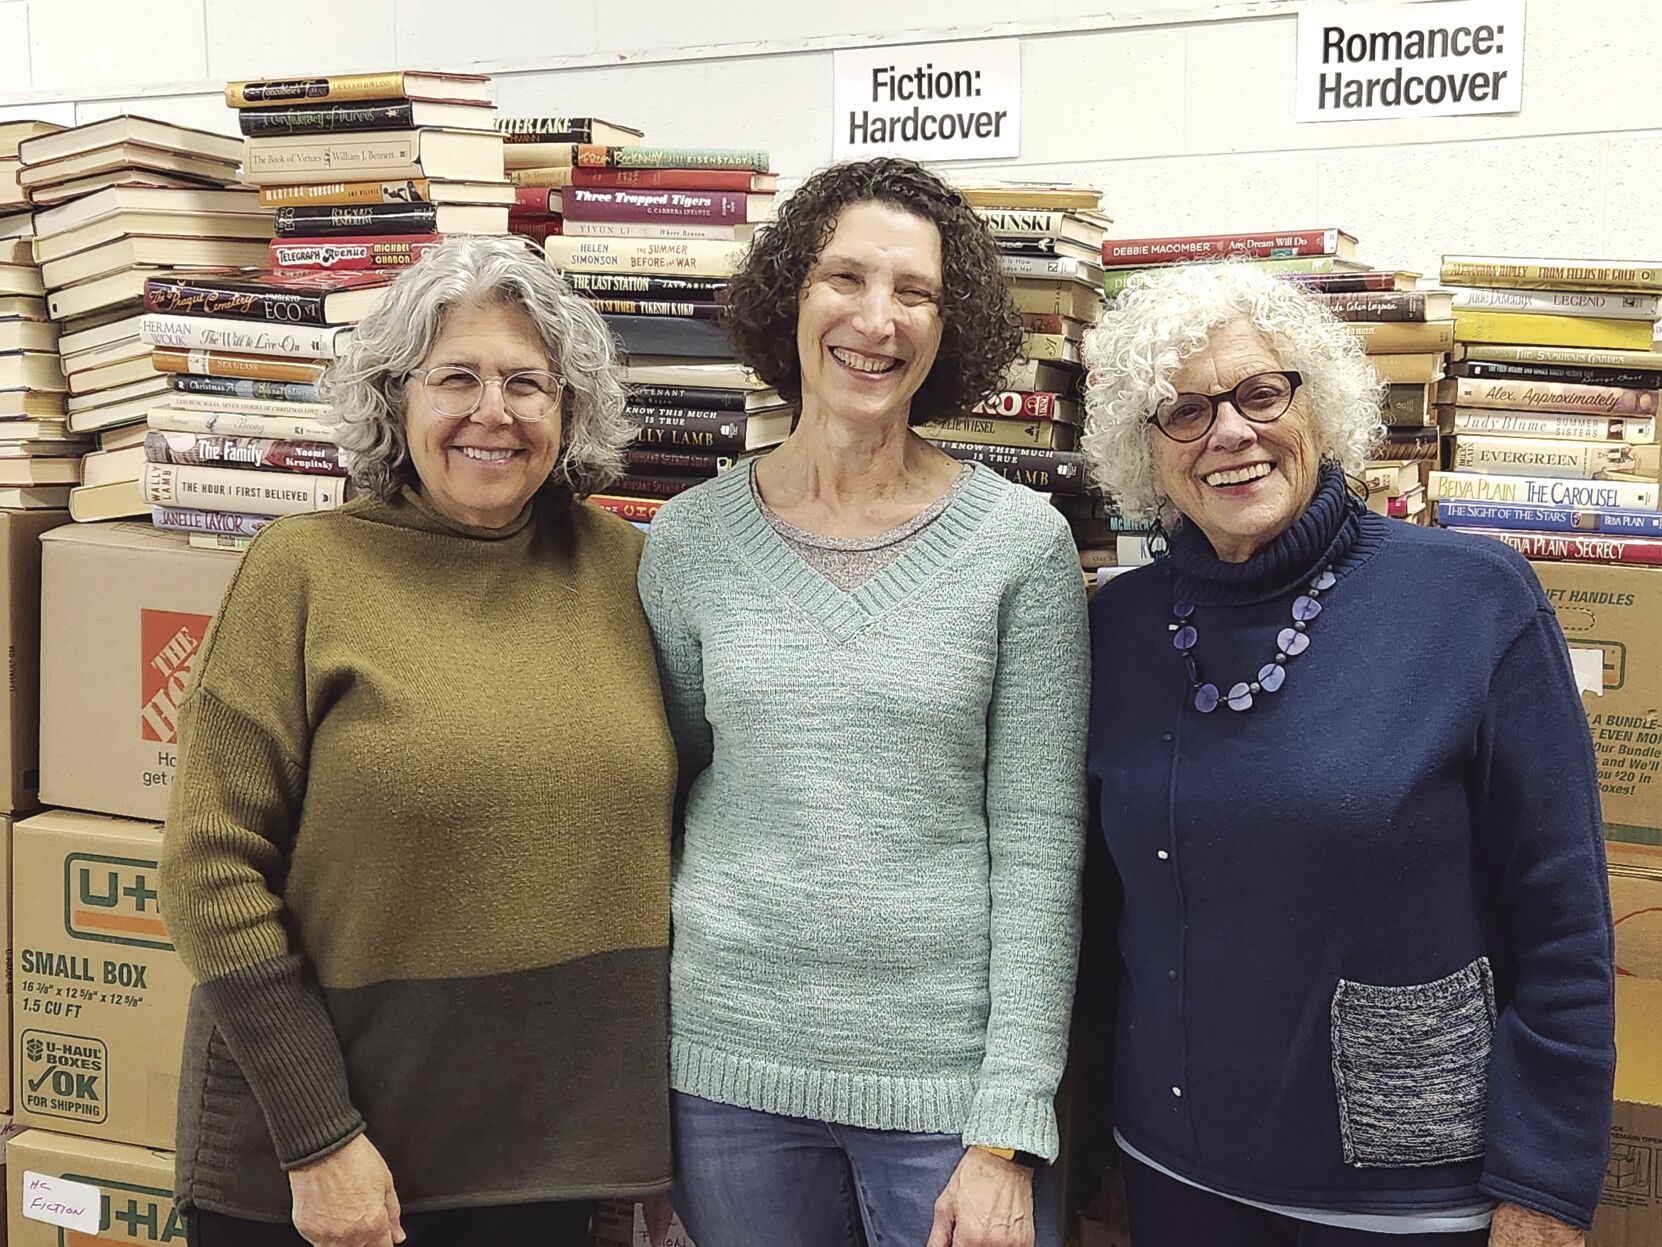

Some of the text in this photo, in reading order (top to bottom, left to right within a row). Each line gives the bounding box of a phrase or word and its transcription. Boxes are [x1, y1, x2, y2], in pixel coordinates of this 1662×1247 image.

[1322, 25, 1505, 64] Romance:
[872, 63, 981, 102] Fiction:
[1318, 67, 1508, 110] Hardcover
[535, 117, 572, 134] LAKE
[849, 106, 1007, 145] Hardcover
[253, 154, 267, 164] The
[267, 154, 286, 164] Book
[286, 153, 295, 162] of
[332, 151, 360, 161] William
[368, 150, 394, 160] Bennett
[613, 151, 663, 168] ROCKAWAY
[687, 154, 748, 165] EISENSTADT
[575, 190, 712, 207] Three Trapped Tigers
[580, 225, 631, 235] YIYUN LI
[980, 212, 1052, 232] OSINSKI
[659, 229, 681, 237] Where
[279, 247, 367, 263] TELEGRAPH Avenue
[373, 243, 410, 253] MICHAEL
[580, 243, 609, 253] HELEN
[648, 244, 688, 256] SUMMER
[1112, 237, 1307, 257] DEBBIE MACOMBER Dream Will Do
[571, 254, 618, 266] SIMONSON
[630, 256, 696, 269] BEFORE WAR
[1499, 265, 1529, 278] RIPLEY
[1538, 266, 1564, 279] FROM
[1566, 268, 1597, 280] FIELDS
[1598, 268, 1608, 281] OF
[1612, 269, 1636, 281] GOLD
[573, 274, 650, 292] THE LAST STATION
[203, 292, 260, 314] Cemetery
[1346, 301, 1368, 312] Cohen
[1553, 295, 1606, 308] LEGEND
[264, 301, 302, 322] ECO
[143, 319, 192, 335] HERMAN
[153, 334, 187, 347] WOUK
[200, 330, 220, 346] The
[1516, 350, 1533, 360] THE
[1587, 352, 1625, 364] GARDEN
[233, 361, 259, 371] GLASS
[190, 380, 225, 393] Christmas
[1485, 386, 1620, 412] Alex, Approximately
[625, 406, 718, 420] KNOW THIS MUCH
[645, 416, 686, 426] IS TRUE
[963, 419, 995, 434] WIESEL
[1463, 413, 1599, 432] Judy Blume SUMMER
[671, 430, 714, 447] LAMB
[1554, 428, 1598, 438] SISTERS
[199, 440, 263, 467] The Family
[294, 447, 326, 459] Naomi
[951, 442, 985, 452] KNOW
[988, 445, 1016, 455] THIS
[1020, 449, 1054, 458] MUCH
[1480, 449, 1578, 467] EVERGREEN
[285, 457, 333, 471] Krupitsky
[988, 454, 1018, 464] TRUE
[151, 466, 162, 501] WALLY
[162, 470, 172, 500] LAMB
[1003, 467, 1049, 486] LAMB
[182, 482, 198, 493] THE
[202, 483, 226, 496] HOUR
[236, 486, 261, 499] FIRST
[265, 489, 308, 501] BELIEVED
[1439, 476, 1620, 508] BELVA PLAIN THE CAROUSEL
[159, 510, 244, 532] JANELLE TAYLOR
[1448, 504, 1645, 527] THE SIGHT OF THE STARS BELVA PLAIN
[1533, 535, 1568, 557] PLAIN
[1575, 537, 1625, 560] SECRECY
[1568, 590, 1634, 607] HANDLES
[150, 625, 198, 678] THE
[1592, 714, 1602, 726] A
[1599, 729, 1633, 744] EVEN
[1594, 742, 1661, 759] Our Bundle
[1602, 758, 1660, 772] and We'll
[142, 772, 168, 787] get
[1597, 771, 1652, 784] ou $20 in
[21, 948, 95, 982] SMALL
[103, 960, 148, 989] BOX
[22, 981, 34, 992] 16
[66, 988, 77, 999] 12
[110, 994, 123, 1005] 12
[22, 997, 82, 1019] 1.5 CU FT
[46, 1042, 102, 1060] U-HAUL
[46, 1054, 102, 1072] BOXES
[52, 1070, 99, 1102] OK
[27, 1094, 100, 1117] FOR SHIPPING
[30, 1179, 52, 1191] HC
[30, 1197, 86, 1216] FICTION
